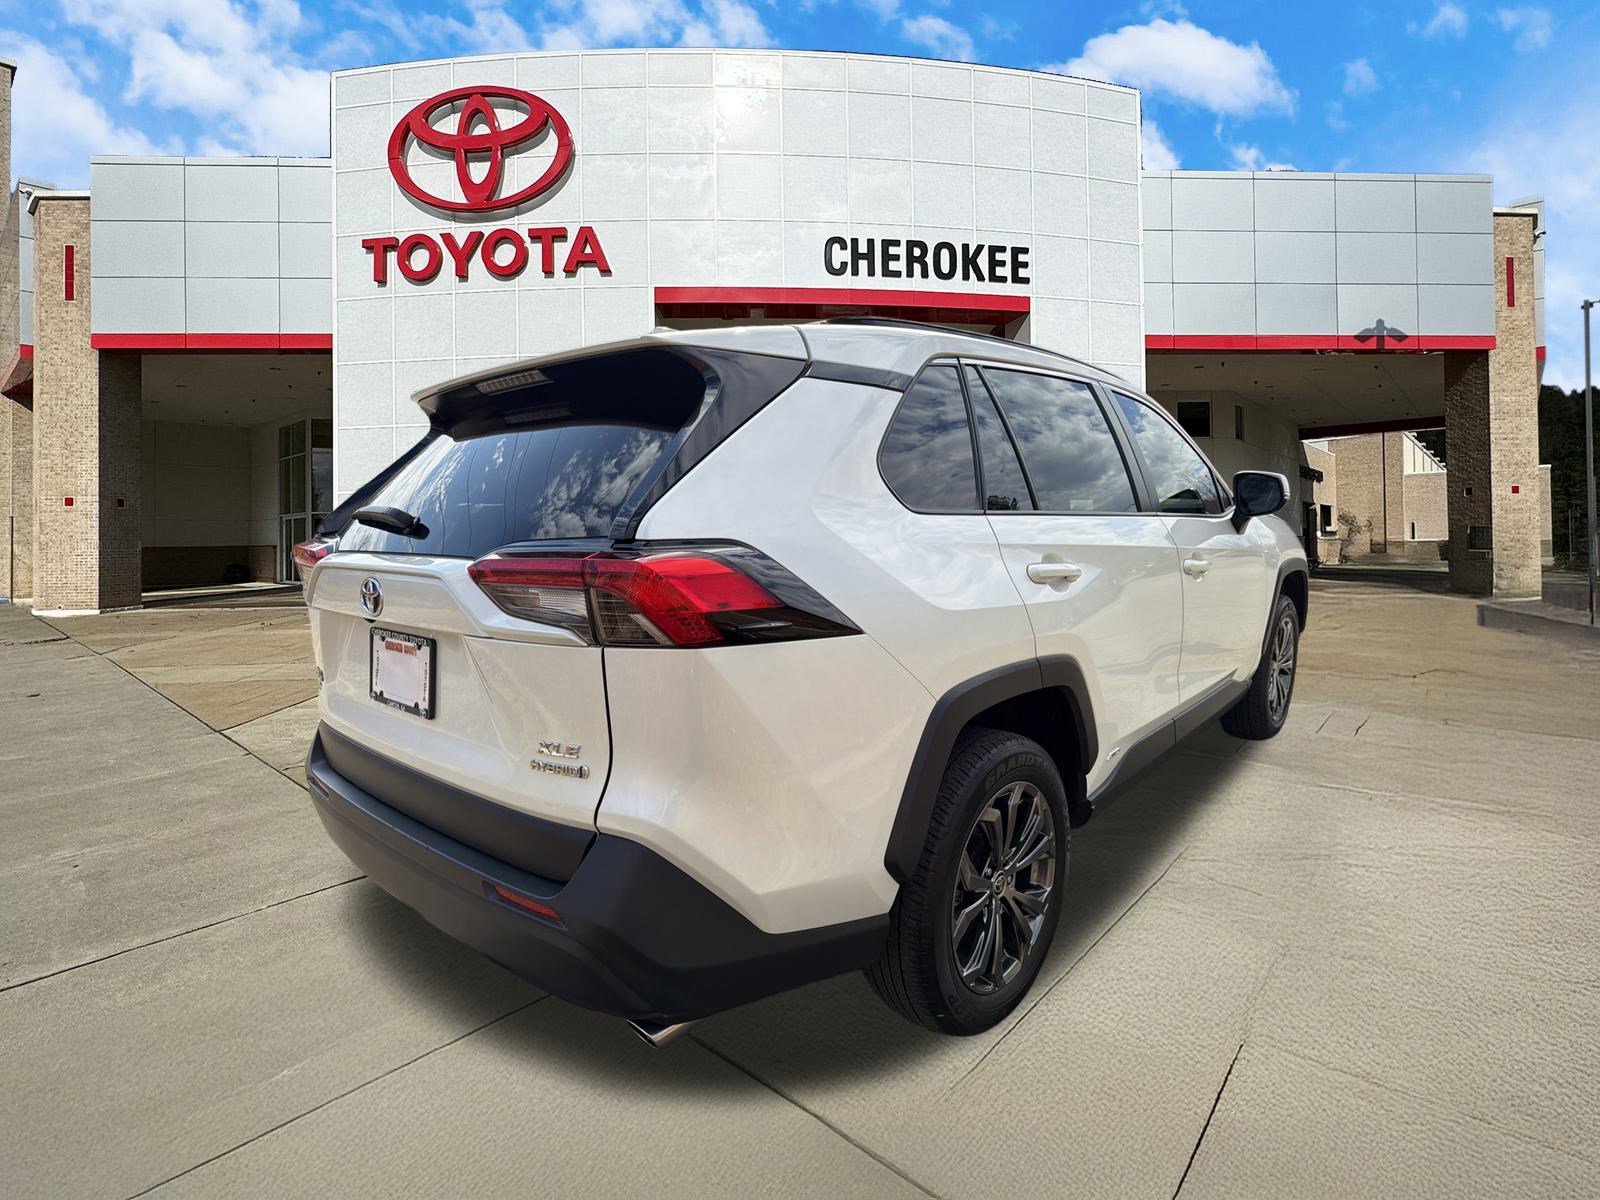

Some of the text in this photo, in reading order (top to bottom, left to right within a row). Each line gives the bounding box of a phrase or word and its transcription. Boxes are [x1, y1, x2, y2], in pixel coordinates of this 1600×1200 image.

[361, 226, 612, 287] TOYOTA
[824, 236, 1030, 284] CHEROKEE
[536, 740, 581, 759] XLE
[530, 759, 578, 777] HYBRID
